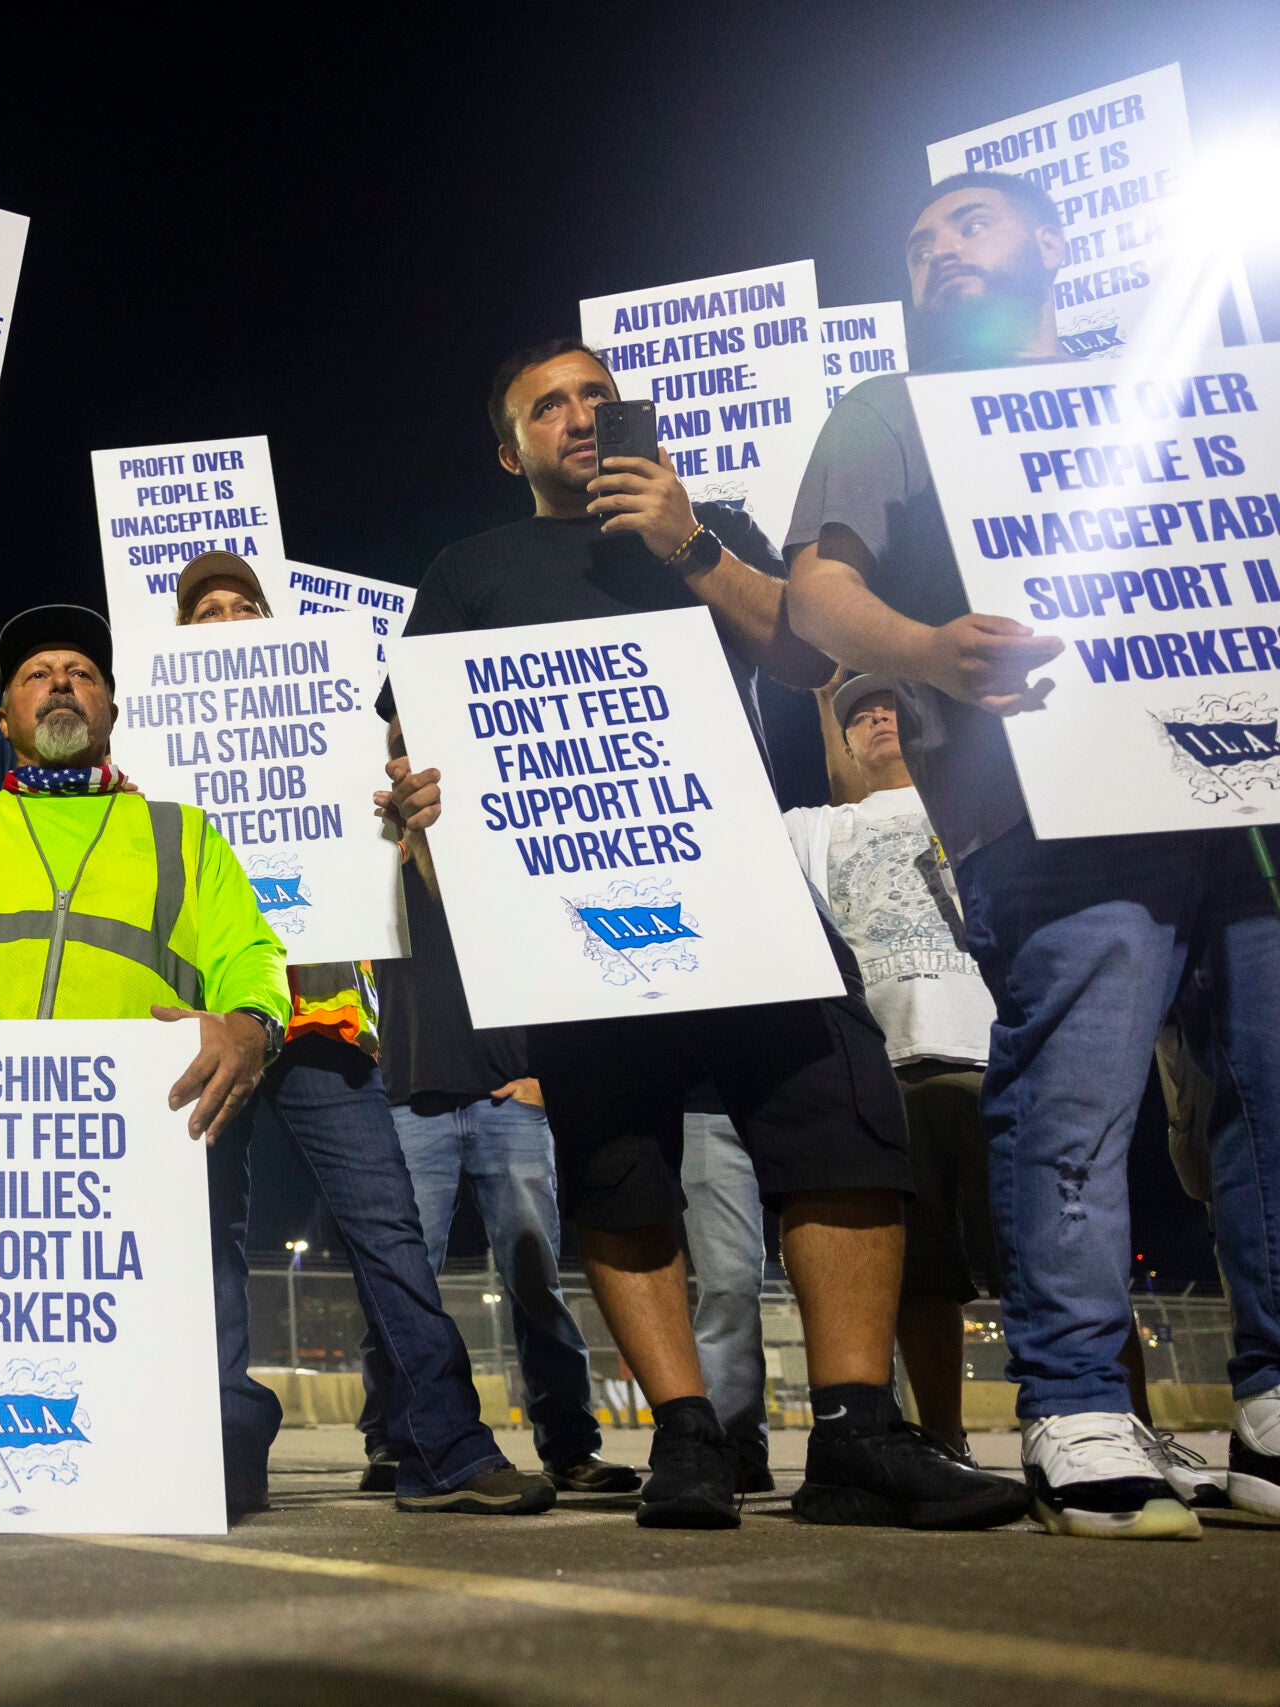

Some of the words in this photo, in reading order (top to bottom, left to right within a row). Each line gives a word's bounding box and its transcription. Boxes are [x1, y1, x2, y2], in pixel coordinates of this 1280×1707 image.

[965, 120, 1058, 172] PROFIT
[1067, 94, 1146, 142] OVER
[1100, 141, 1130, 173] IS
[613, 281, 785, 334] AUTOMATION
[1053, 260, 1150, 310] RKERS
[753, 316, 809, 349] OUR
[651, 364, 757, 404] FUTURE:
[849, 348, 896, 374] OUR
[657, 409, 711, 441] AND
[719, 396, 792, 433] WITH
[970, 384, 1120, 436] PROFIT
[1135, 372, 1259, 420] OVER
[119, 456, 185, 479] PROFIT
[192, 450, 244, 472] OVER
[716, 441, 760, 473] ILA
[1020, 440, 1190, 494] PEOPLE
[1193, 434, 1246, 478] IS
[137, 483, 207, 507] PEOPLE
[214, 479, 234, 500] IS
[111, 506, 268, 538] UNACCEPTABLE:
[289, 571, 353, 600] PROFIT
[357, 587, 405, 614] OVER
[1023, 562, 1233, 621] SUPPORT
[151, 640, 329, 687] AUTOMATION
[464, 642, 648, 694] MACHINES
[1075, 625, 1280, 683] WORKER
[126, 691, 217, 729] HURTS
[224, 678, 362, 721] FAMILIES:
[468, 693, 571, 739] DON'T
[579, 684, 669, 729] FEED
[167, 731, 211, 767] ILA
[217, 722, 328, 763] STANDS
[494, 731, 670, 783] FAMILIES:
[195, 769, 248, 806] FOR
[257, 765, 307, 801] JOB
[480, 779, 642, 831] SUPPORT
[648, 772, 713, 816] ILA
[206, 804, 343, 847] OTECTION
[515, 821, 702, 876] WORKERS
[597, 914, 683, 939] I.L.A.
[32, 1112, 126, 1160] FEED
[83, 1230, 143, 1280] ILA
